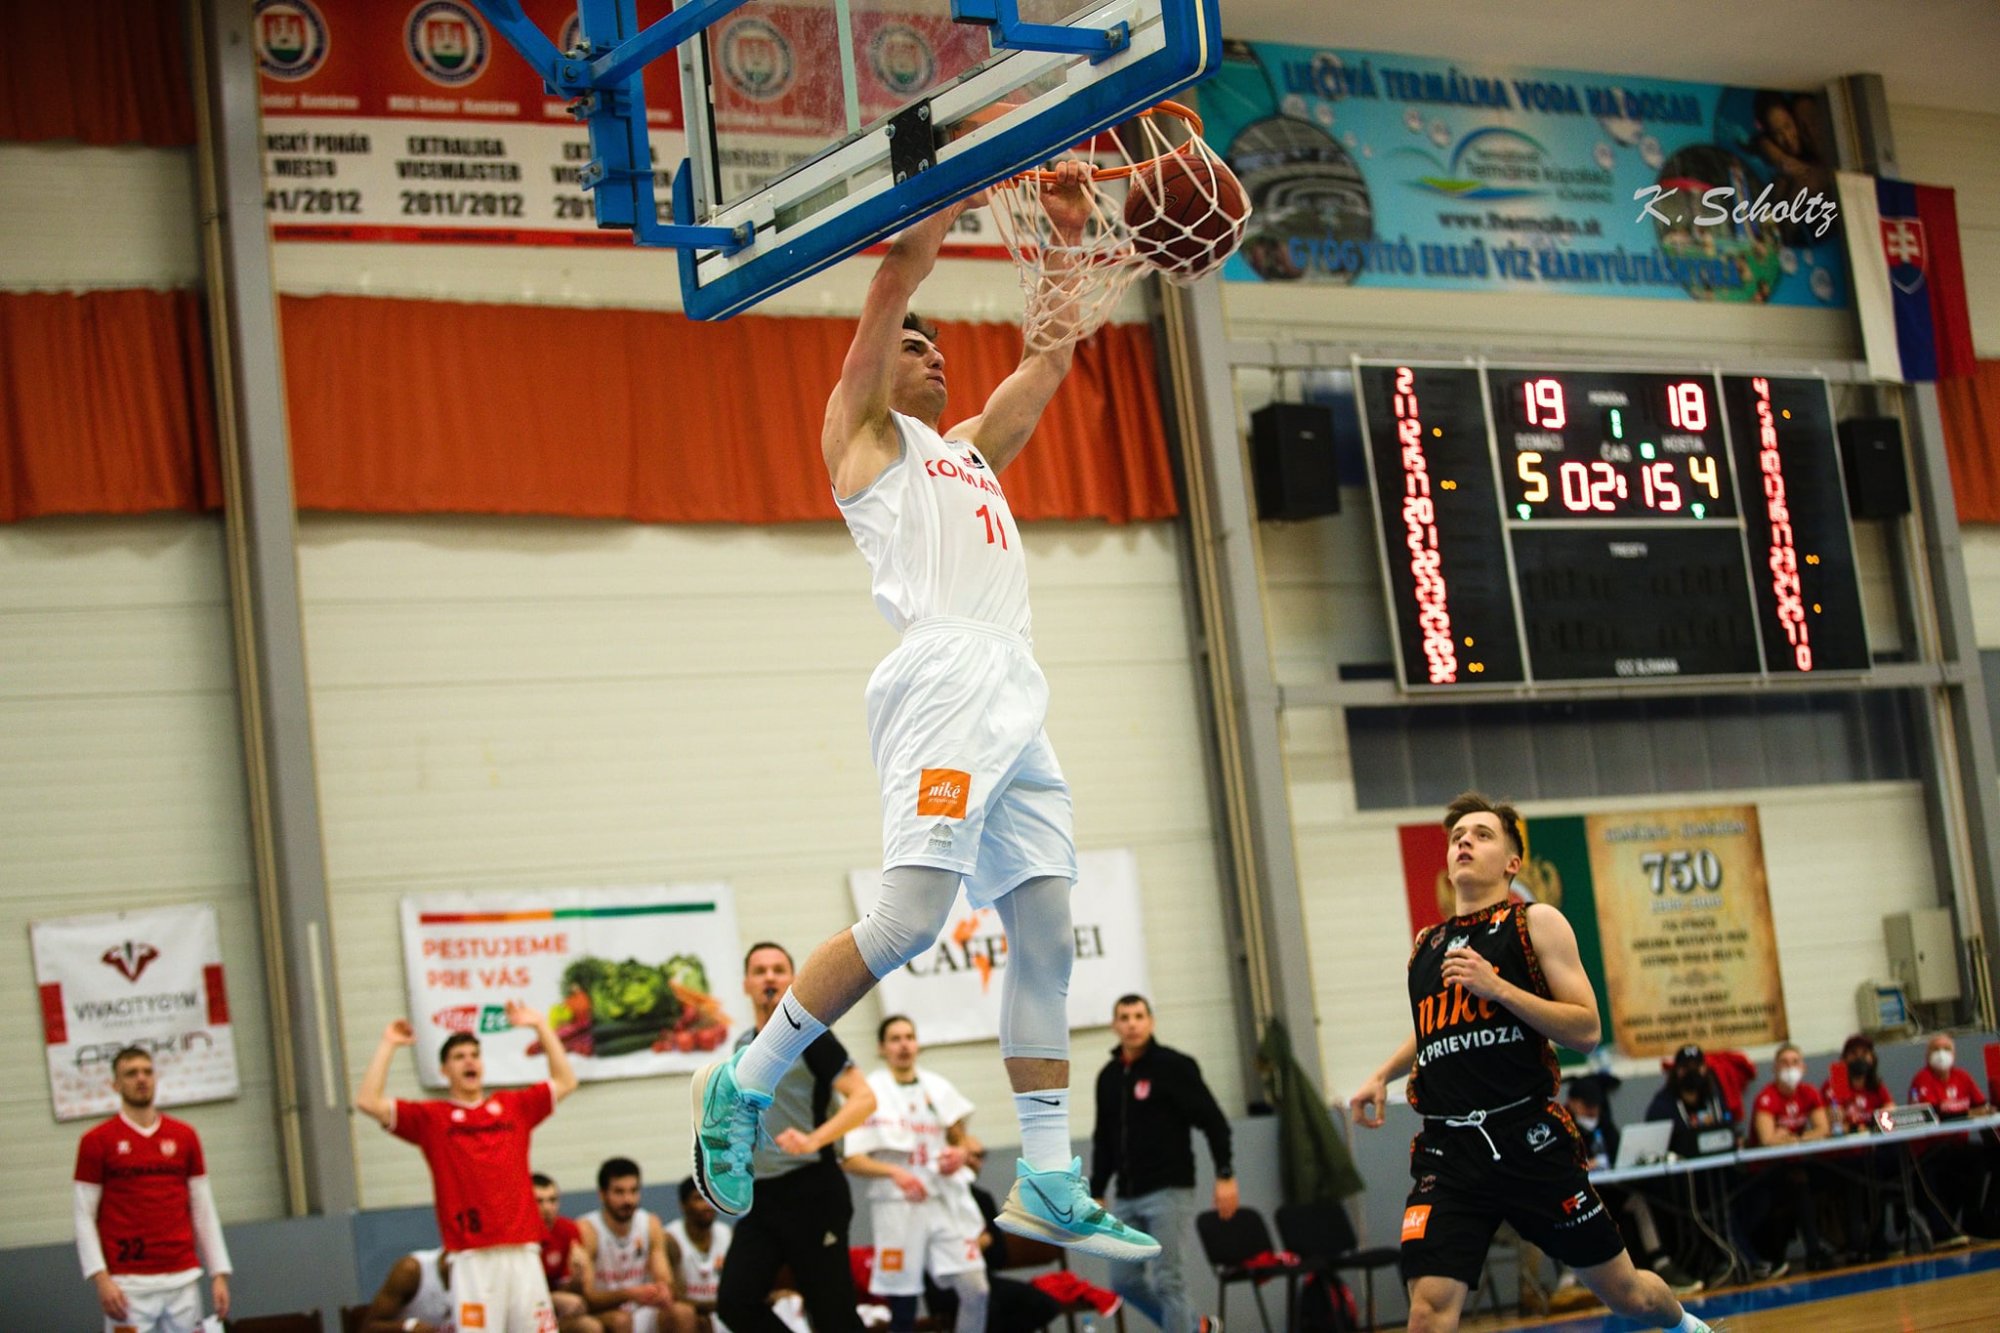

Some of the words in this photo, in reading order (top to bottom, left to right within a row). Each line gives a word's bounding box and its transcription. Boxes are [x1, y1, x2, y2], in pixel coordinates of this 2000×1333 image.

[406, 135, 506, 157] EXTRALIGA
[396, 161, 522, 183] VICEMAJSTER
[401, 190, 525, 217] 2011/2012
[1396, 367, 1414, 394] 2
[1752, 377, 1771, 401] 4
[1524, 378, 1566, 429] 19
[1667, 383, 1707, 431] 18
[1756, 400, 1774, 426] 5
[1398, 418, 1423, 446] 12
[1406, 469, 1431, 497] 17
[1517, 451, 1549, 502] 5
[1688, 456, 1720, 499] 4
[1403, 496, 1435, 525] 20
[1407, 522, 1439, 550] 21
[1411, 548, 1441, 577] 22
[1415, 575, 1446, 603] 23
[1419, 601, 1451, 630] 25
[1796, 643, 1813, 672] 0
[1640, 848, 1722, 896] 750
[422, 932, 570, 959] PESTUJEME
[426, 969, 471, 990] PRE
[478, 961, 531, 988] VÁS
[1425, 1025, 1525, 1062] PRIEVIDZA
[455, 1208, 482, 1234] 18
[117, 1237, 146, 1263] 22
